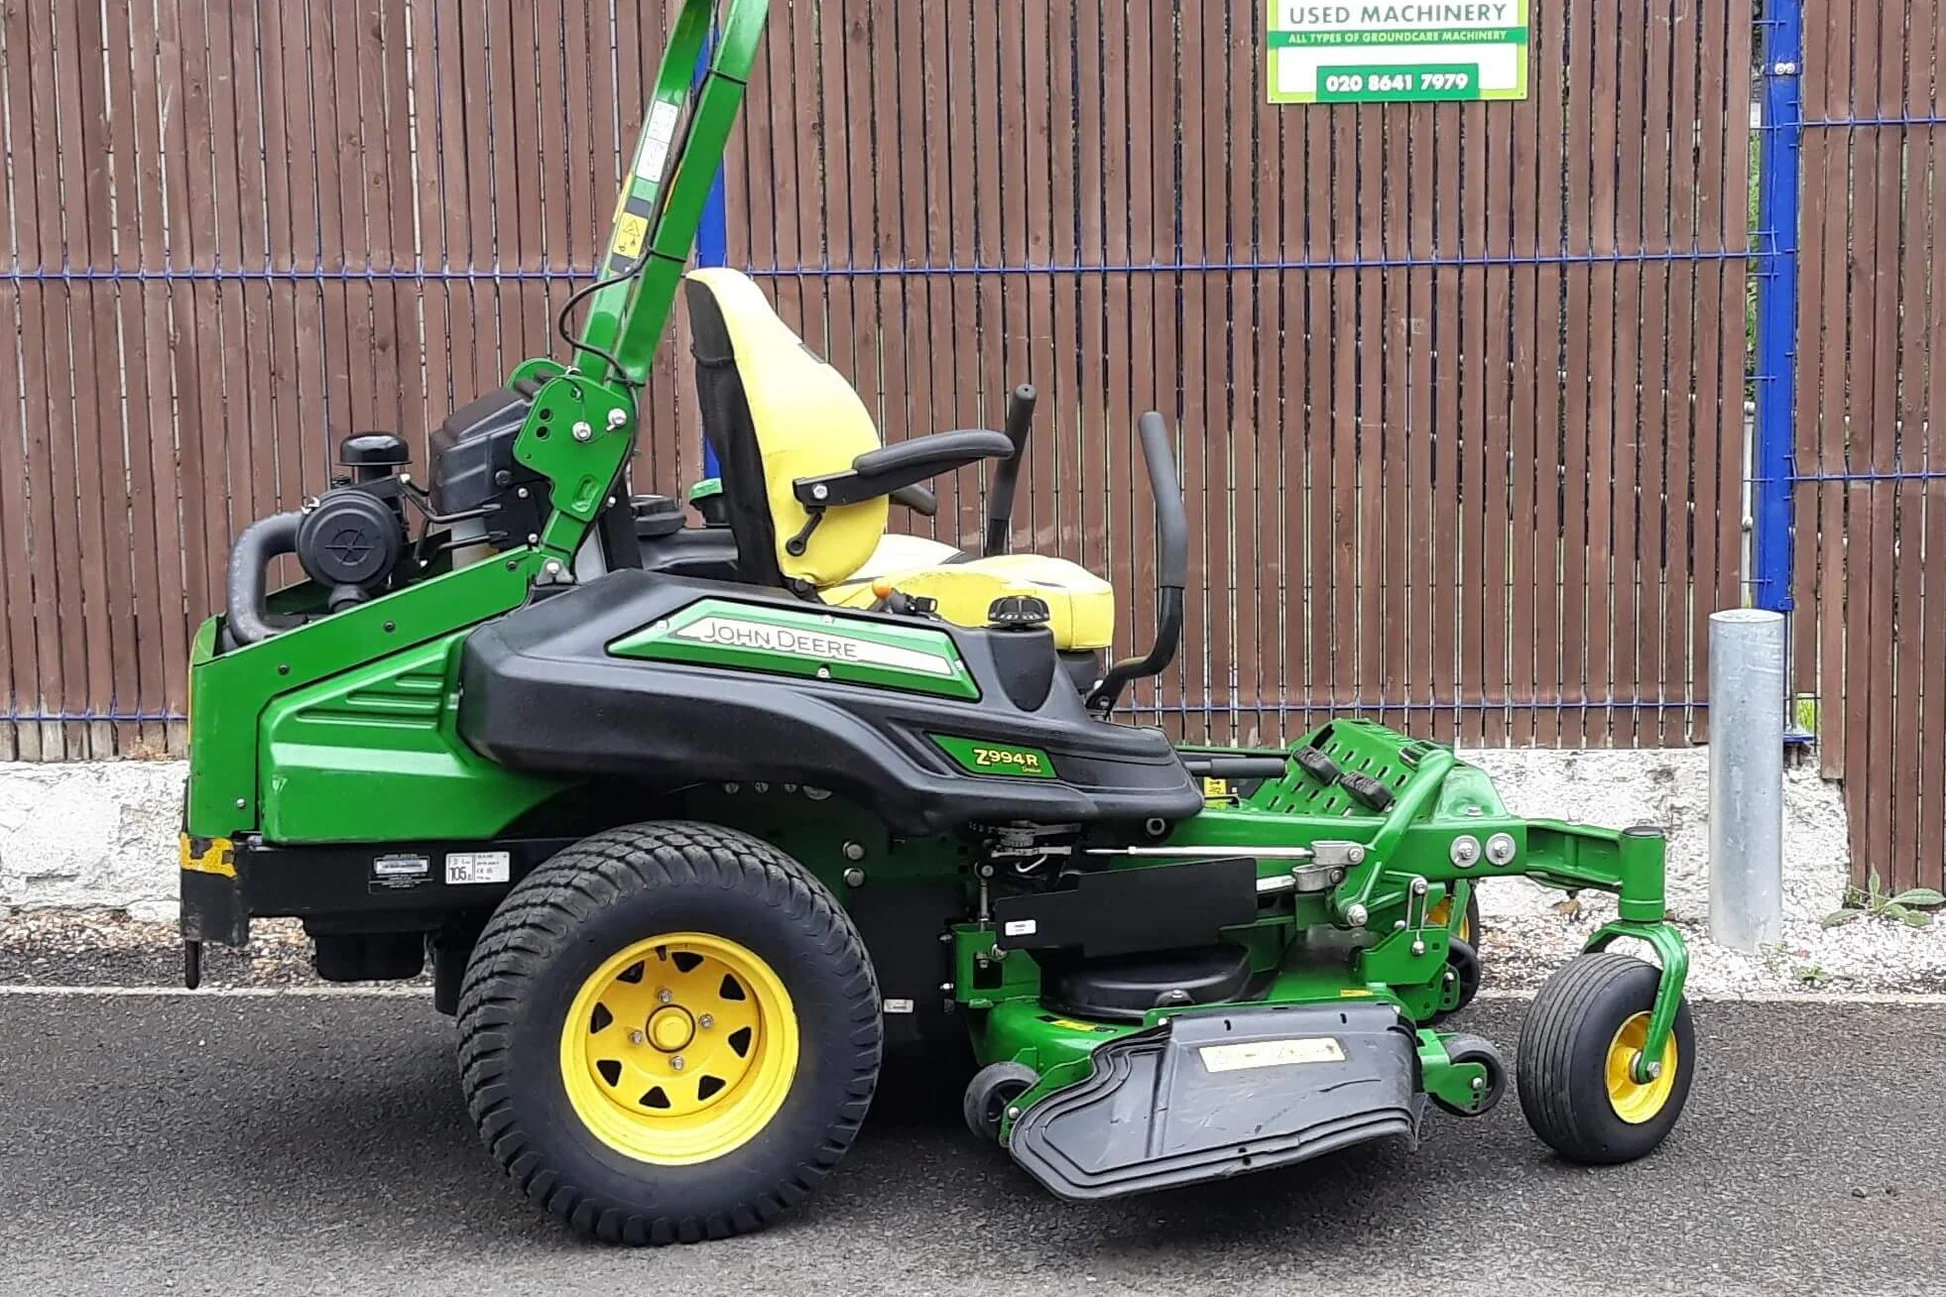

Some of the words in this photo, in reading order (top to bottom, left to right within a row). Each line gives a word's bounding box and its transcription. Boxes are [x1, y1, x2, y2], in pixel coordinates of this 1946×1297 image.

[1290, 6, 1350, 24] USED
[1360, 4, 1507, 23] MACHINERY
[1288, 33, 1308, 43] ALL
[1309, 33, 1342, 43] TYPES
[1344, 33, 1359, 42] OF
[1362, 31, 1439, 42] GROUNDCARE
[1442, 30, 1507, 41] MACHINERY
[1325, 75, 1362, 92] 020
[1367, 74, 1413, 91] 8641
[1420, 73, 1469, 91] 7979
[704, 622, 771, 645] JOHN
[777, 630, 858, 658] DEERE
[973, 749, 1038, 766] Z994R
[450, 866, 467, 881] 105
